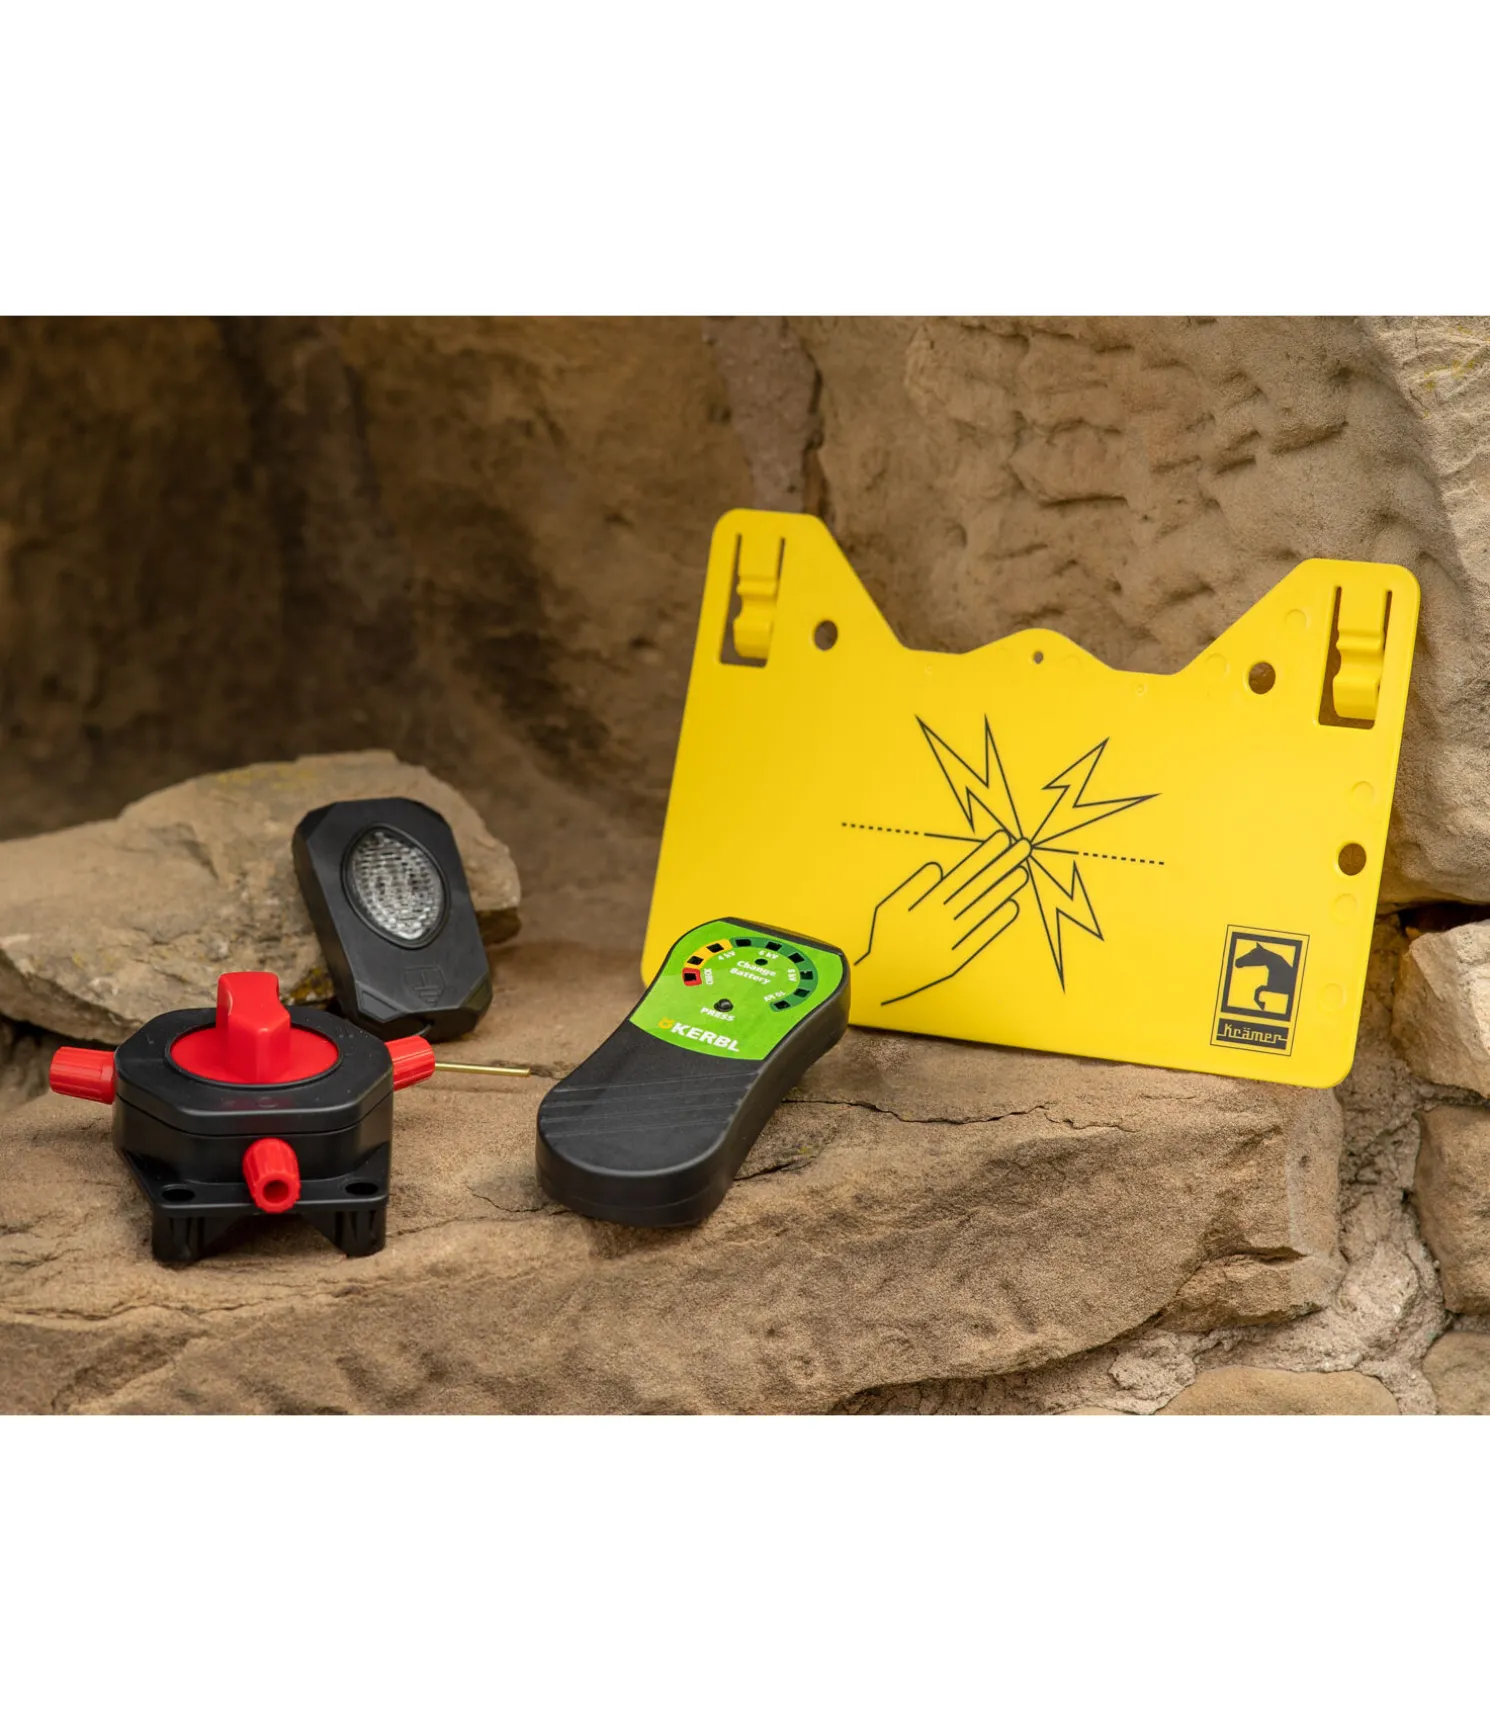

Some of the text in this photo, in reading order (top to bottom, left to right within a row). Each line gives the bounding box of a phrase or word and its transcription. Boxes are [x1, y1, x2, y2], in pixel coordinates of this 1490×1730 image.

[729, 967, 771, 984] Battery
[737, 960, 777, 977] Change
[700, 1007, 735, 1021] PRESS
[671, 1022, 739, 1052] KERBL
[1217, 1023, 1288, 1044] Krämer
